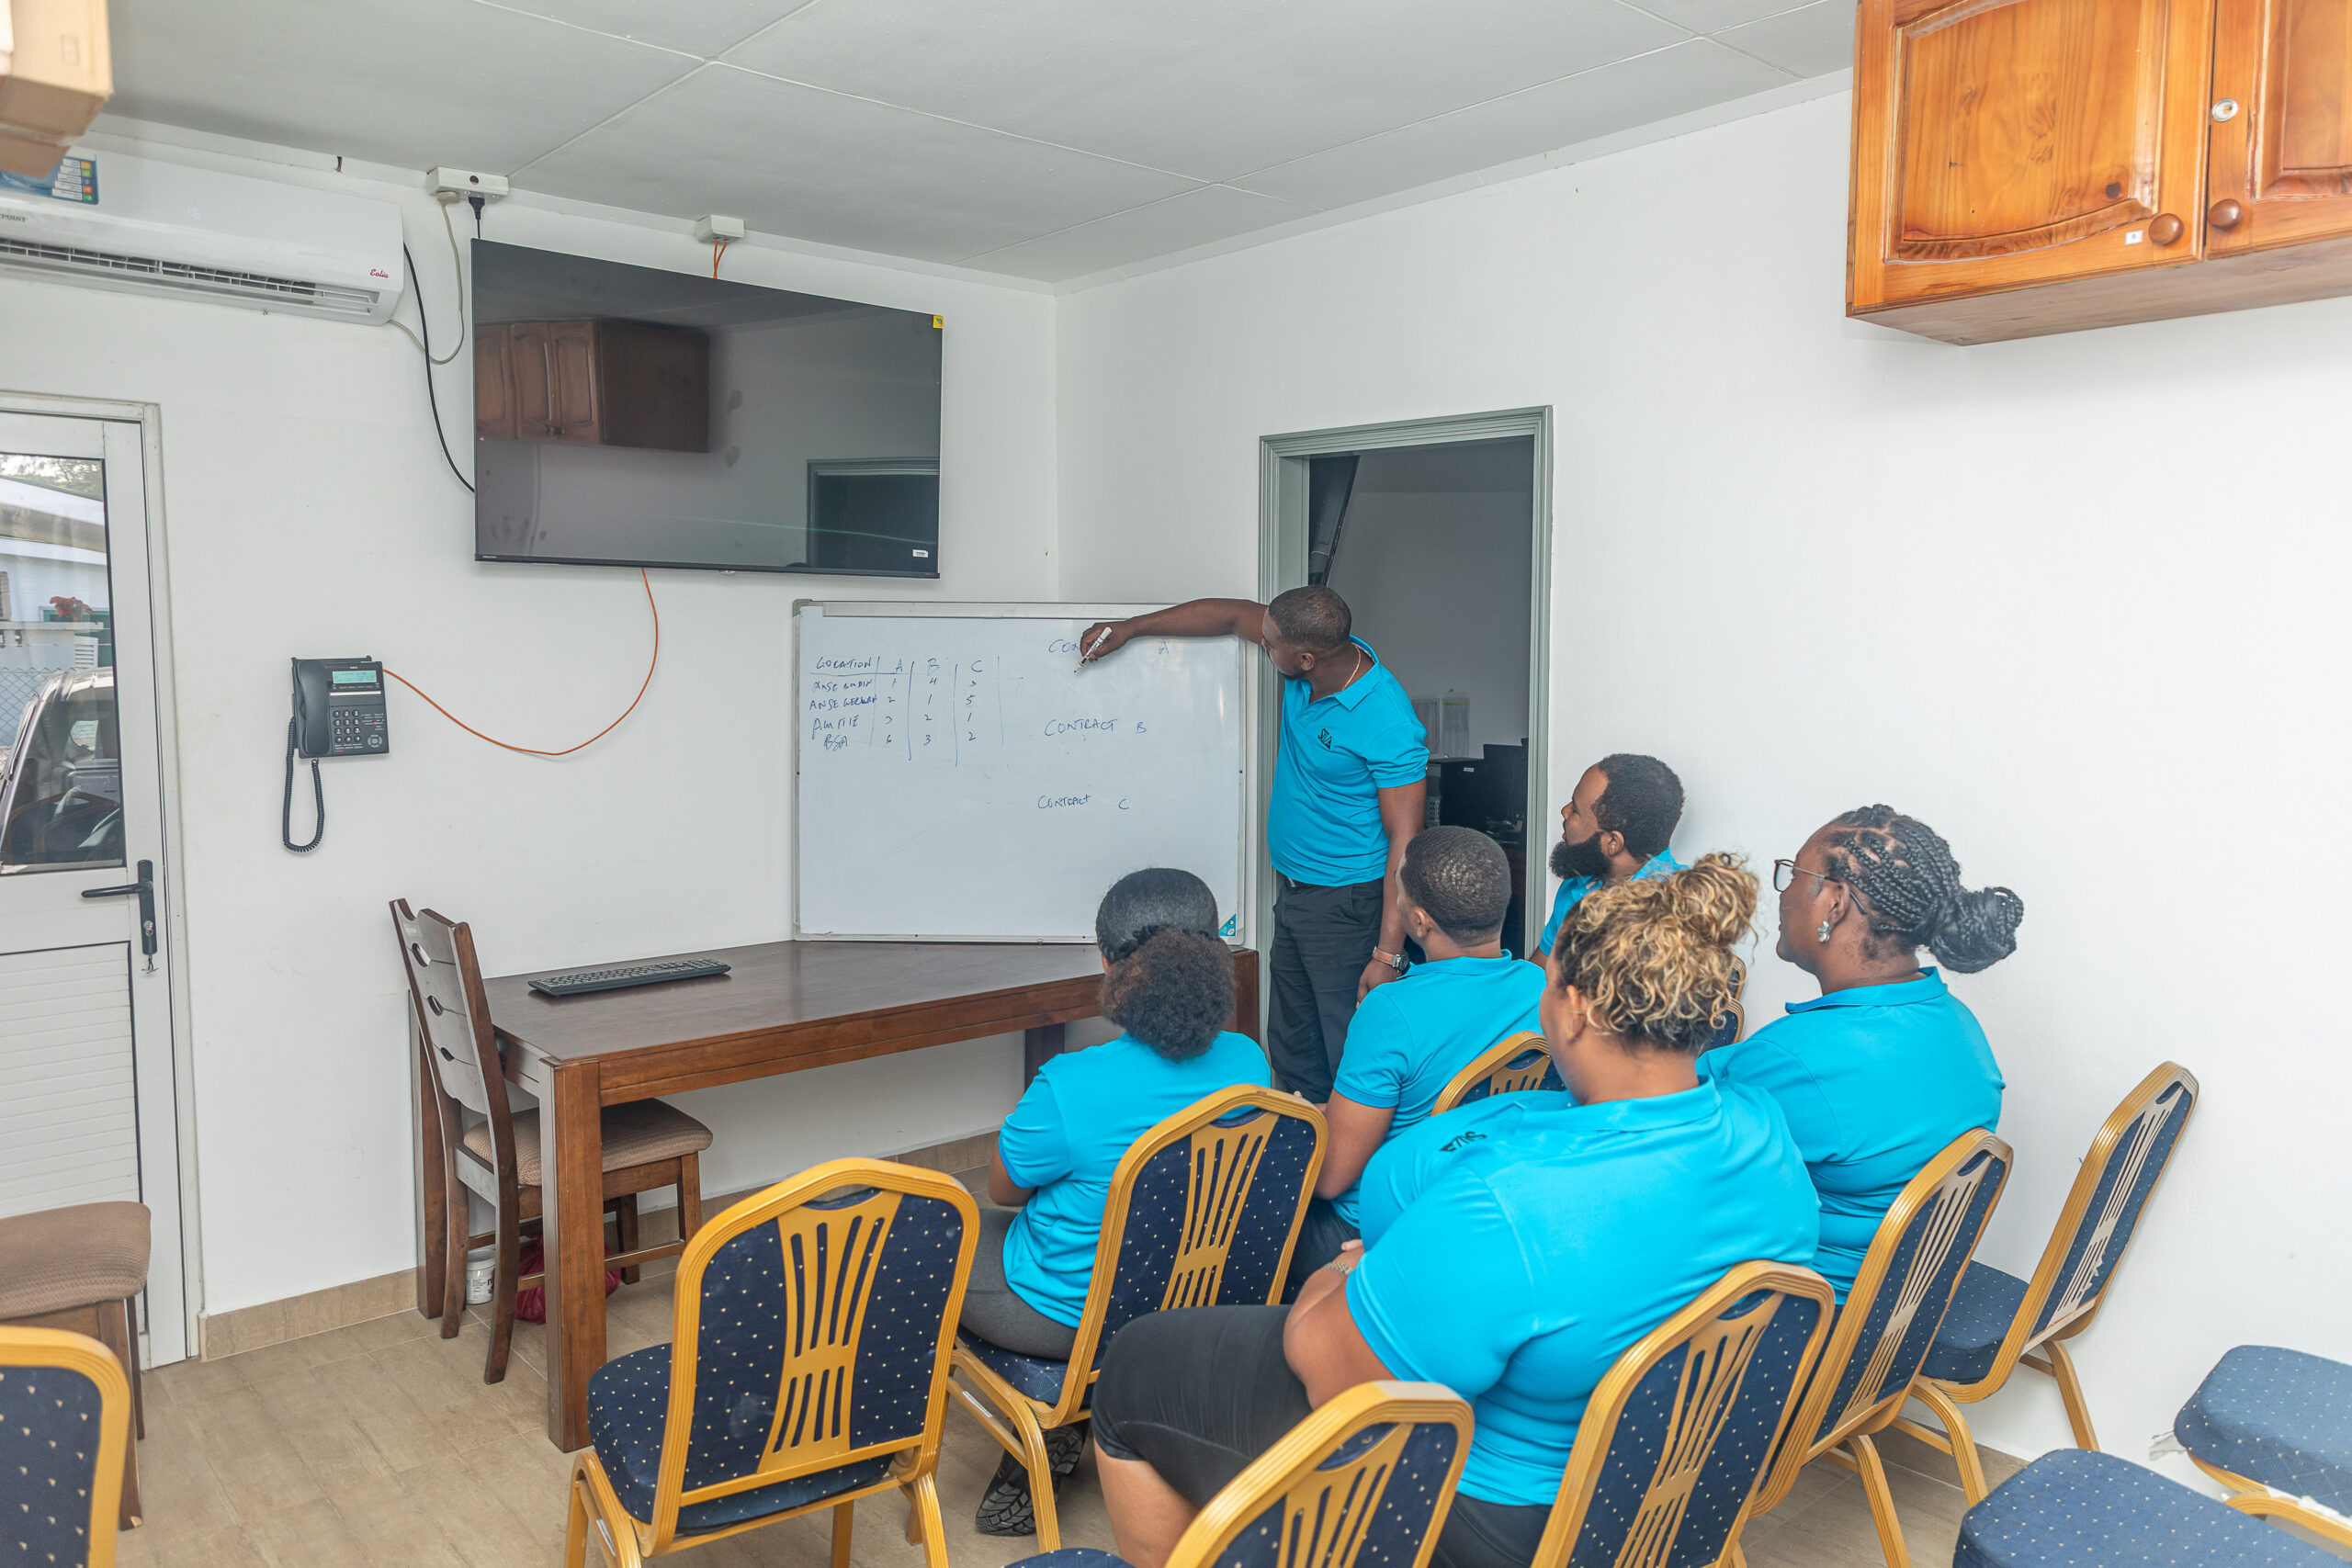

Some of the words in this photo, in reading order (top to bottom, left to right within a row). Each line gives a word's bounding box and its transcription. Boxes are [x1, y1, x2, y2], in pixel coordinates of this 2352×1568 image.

[816, 656, 872, 670] LOCATION
[895, 658, 903, 673] A
[927, 658, 940, 676] B
[970, 660, 983, 672] C
[808, 698, 839, 711] ANSE
[966, 694, 976, 705] 5
[885, 716, 893, 725] 3
[1044, 718, 1118, 737] CONTRACT
[1135, 721, 1147, 734] B
[922, 735, 932, 746] 3
[968, 731, 977, 741] 2
[1118, 798, 1130, 810] C
